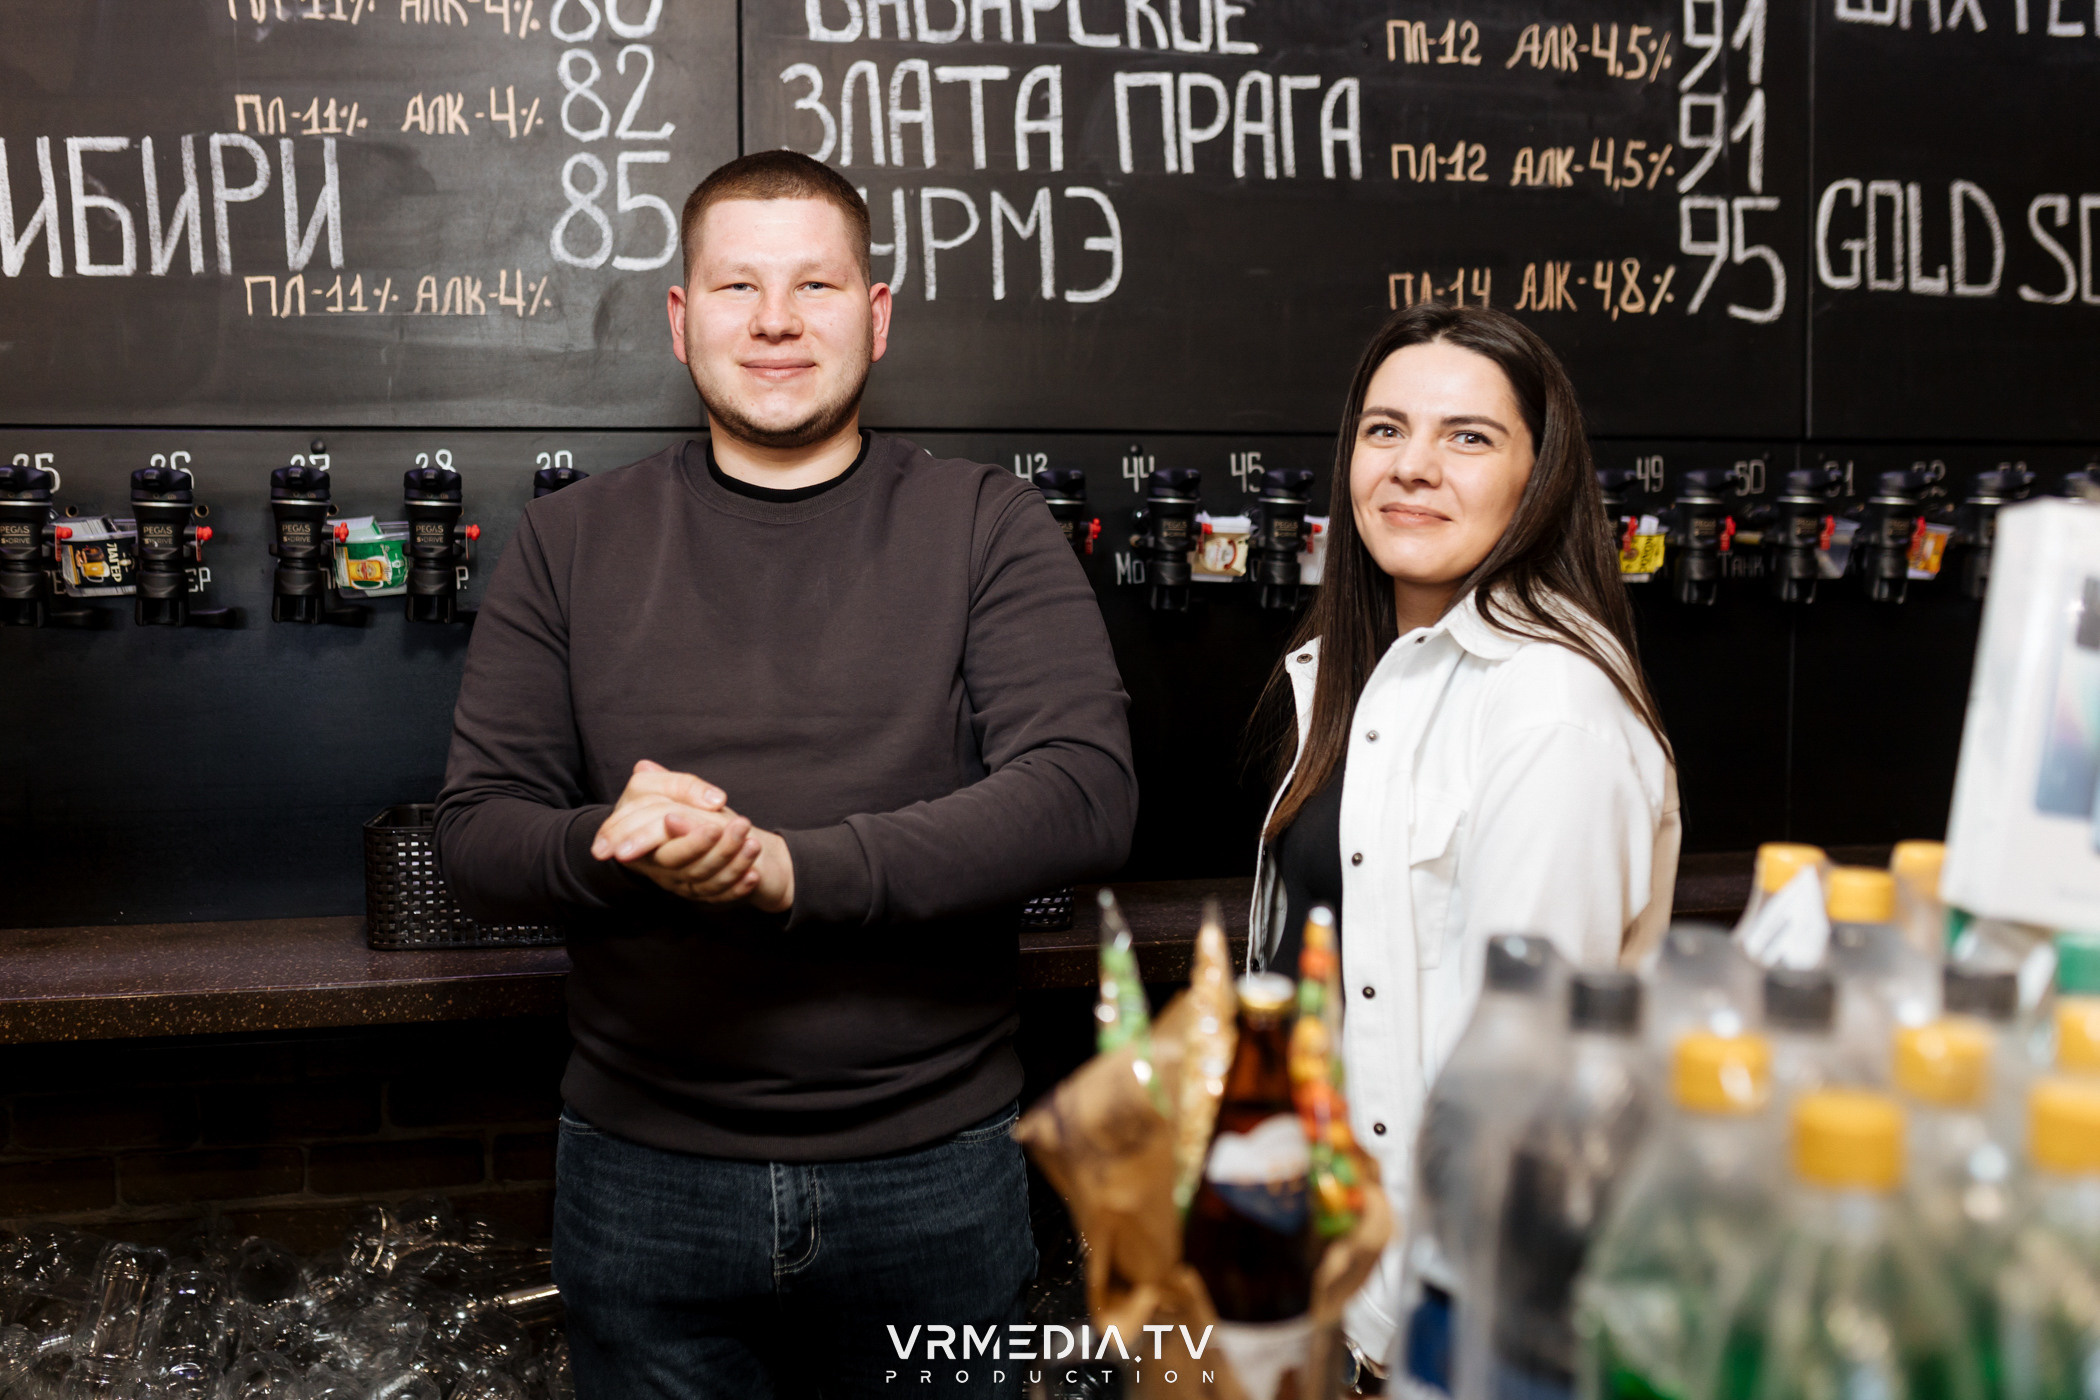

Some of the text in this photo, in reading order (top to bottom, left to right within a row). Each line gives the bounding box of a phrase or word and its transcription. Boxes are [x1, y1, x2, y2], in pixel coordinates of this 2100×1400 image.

[557, 43, 676, 142] 82
[780, 58, 1362, 180] ЗЛАТА ПРАГА
[1677, 88, 1767, 194] 91
[550, 151, 679, 271] 85
[1679, 197, 1787, 324] 95
[1815, 177, 2006, 296] GOLD
[1636, 455, 1664, 493] 49
[143, 525, 173, 534] PEGAS
[282, 524, 311, 533] PEGAS
[416, 524, 444, 533] PEGAS
